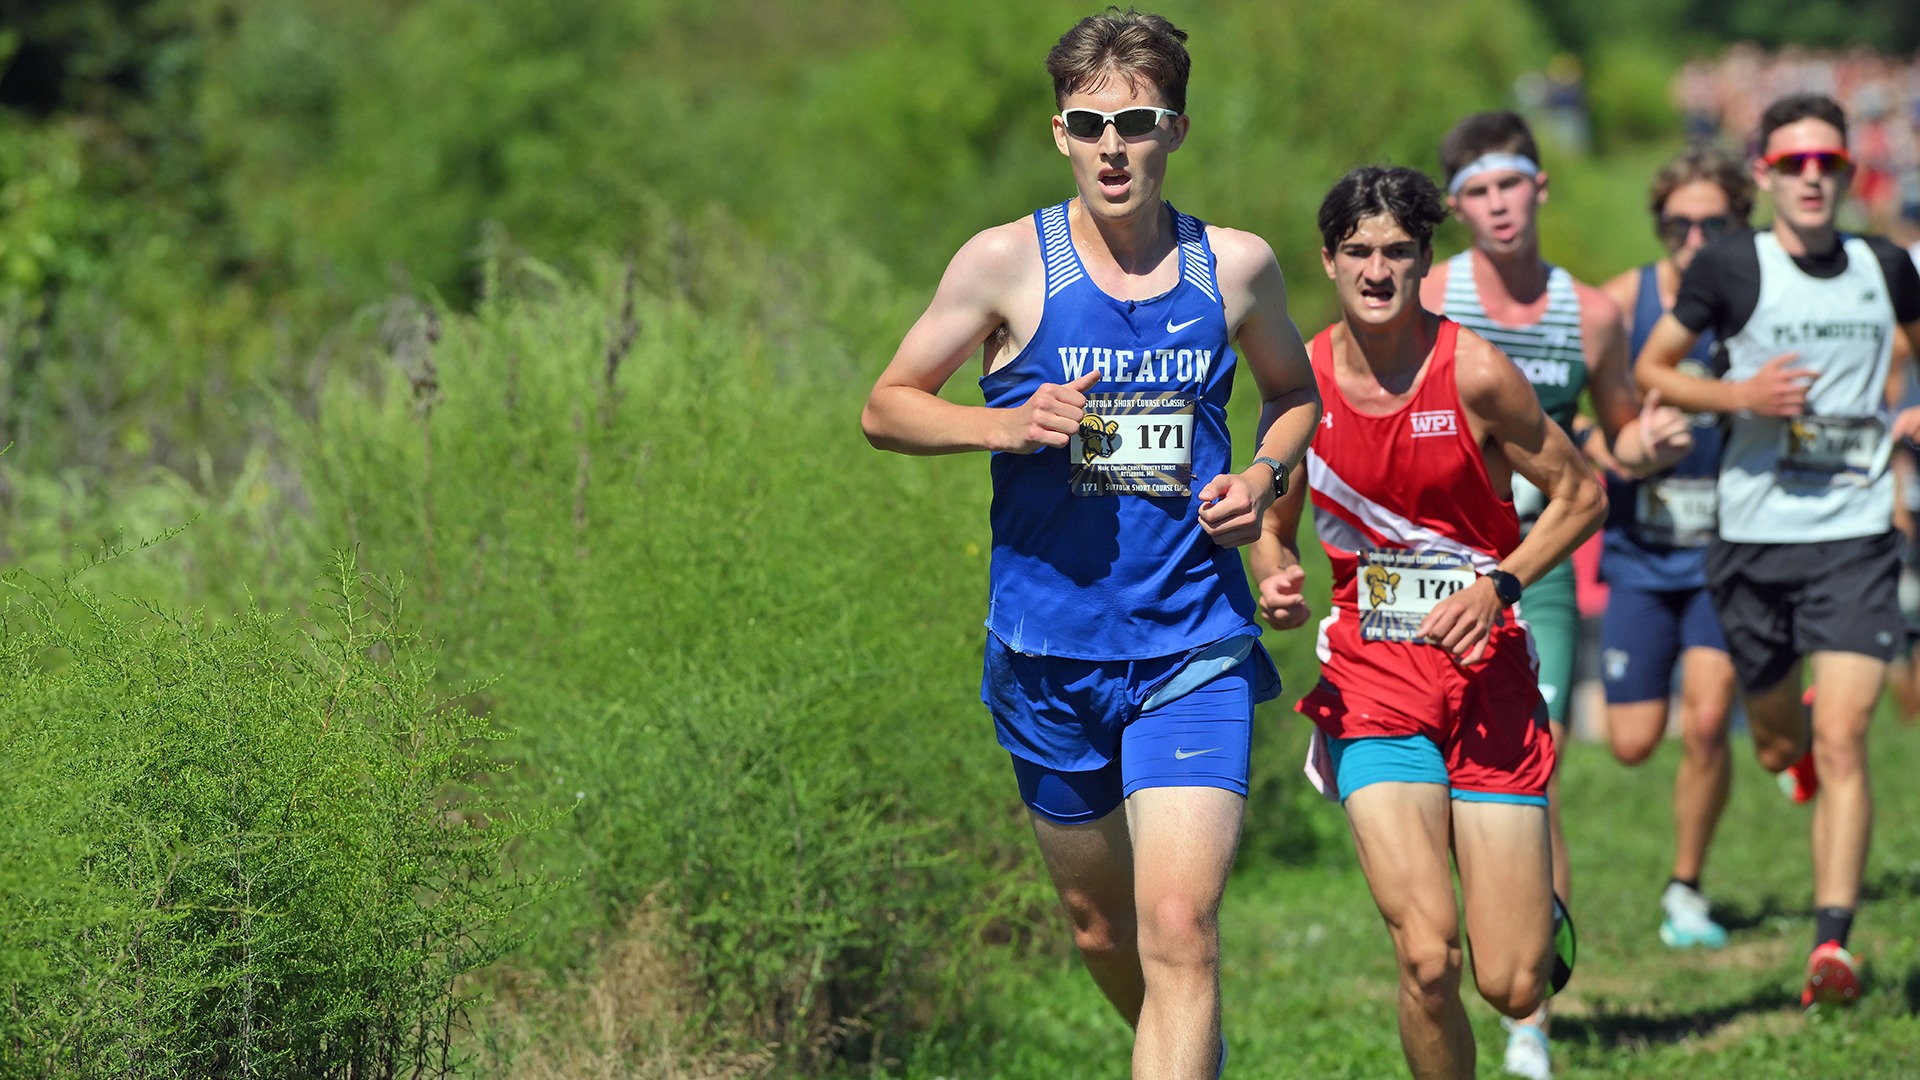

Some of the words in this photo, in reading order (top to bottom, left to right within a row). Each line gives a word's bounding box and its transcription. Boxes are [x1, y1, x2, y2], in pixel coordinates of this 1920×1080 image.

[1058, 347, 1211, 383] WHEATON
[1114, 399, 1135, 408] SHORT
[1137, 398, 1160, 408] COURSE
[1411, 415, 1457, 433] WPI
[1137, 424, 1185, 450] 171
[1081, 483, 1098, 492] 171
[1132, 484, 1150, 492] SHORT
[1152, 484, 1173, 492] COURSE
